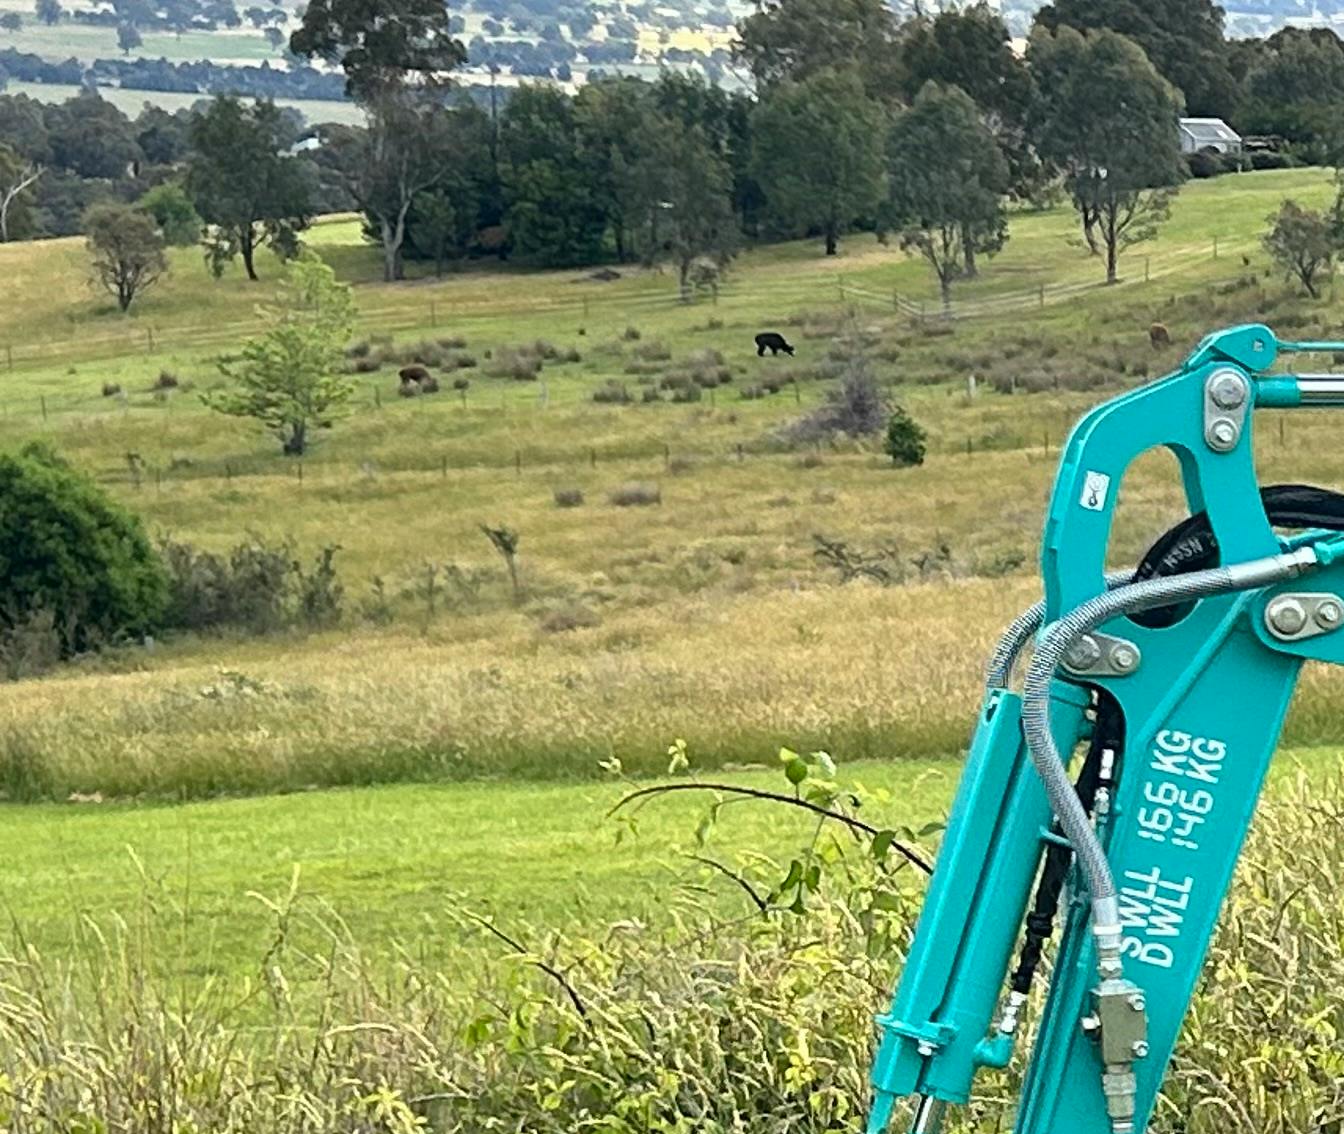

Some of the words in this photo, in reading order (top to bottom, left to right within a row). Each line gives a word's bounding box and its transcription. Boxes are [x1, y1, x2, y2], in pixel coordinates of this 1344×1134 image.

[1151, 729, 1193, 776] KG
[1185, 738, 1227, 784] KG
[1137, 782, 1179, 842] 166
[1171, 790, 1214, 850] 146
[1119, 866, 1160, 928] WLL
[1145, 877, 1194, 936] WLL
[1139, 943, 1173, 968] D
